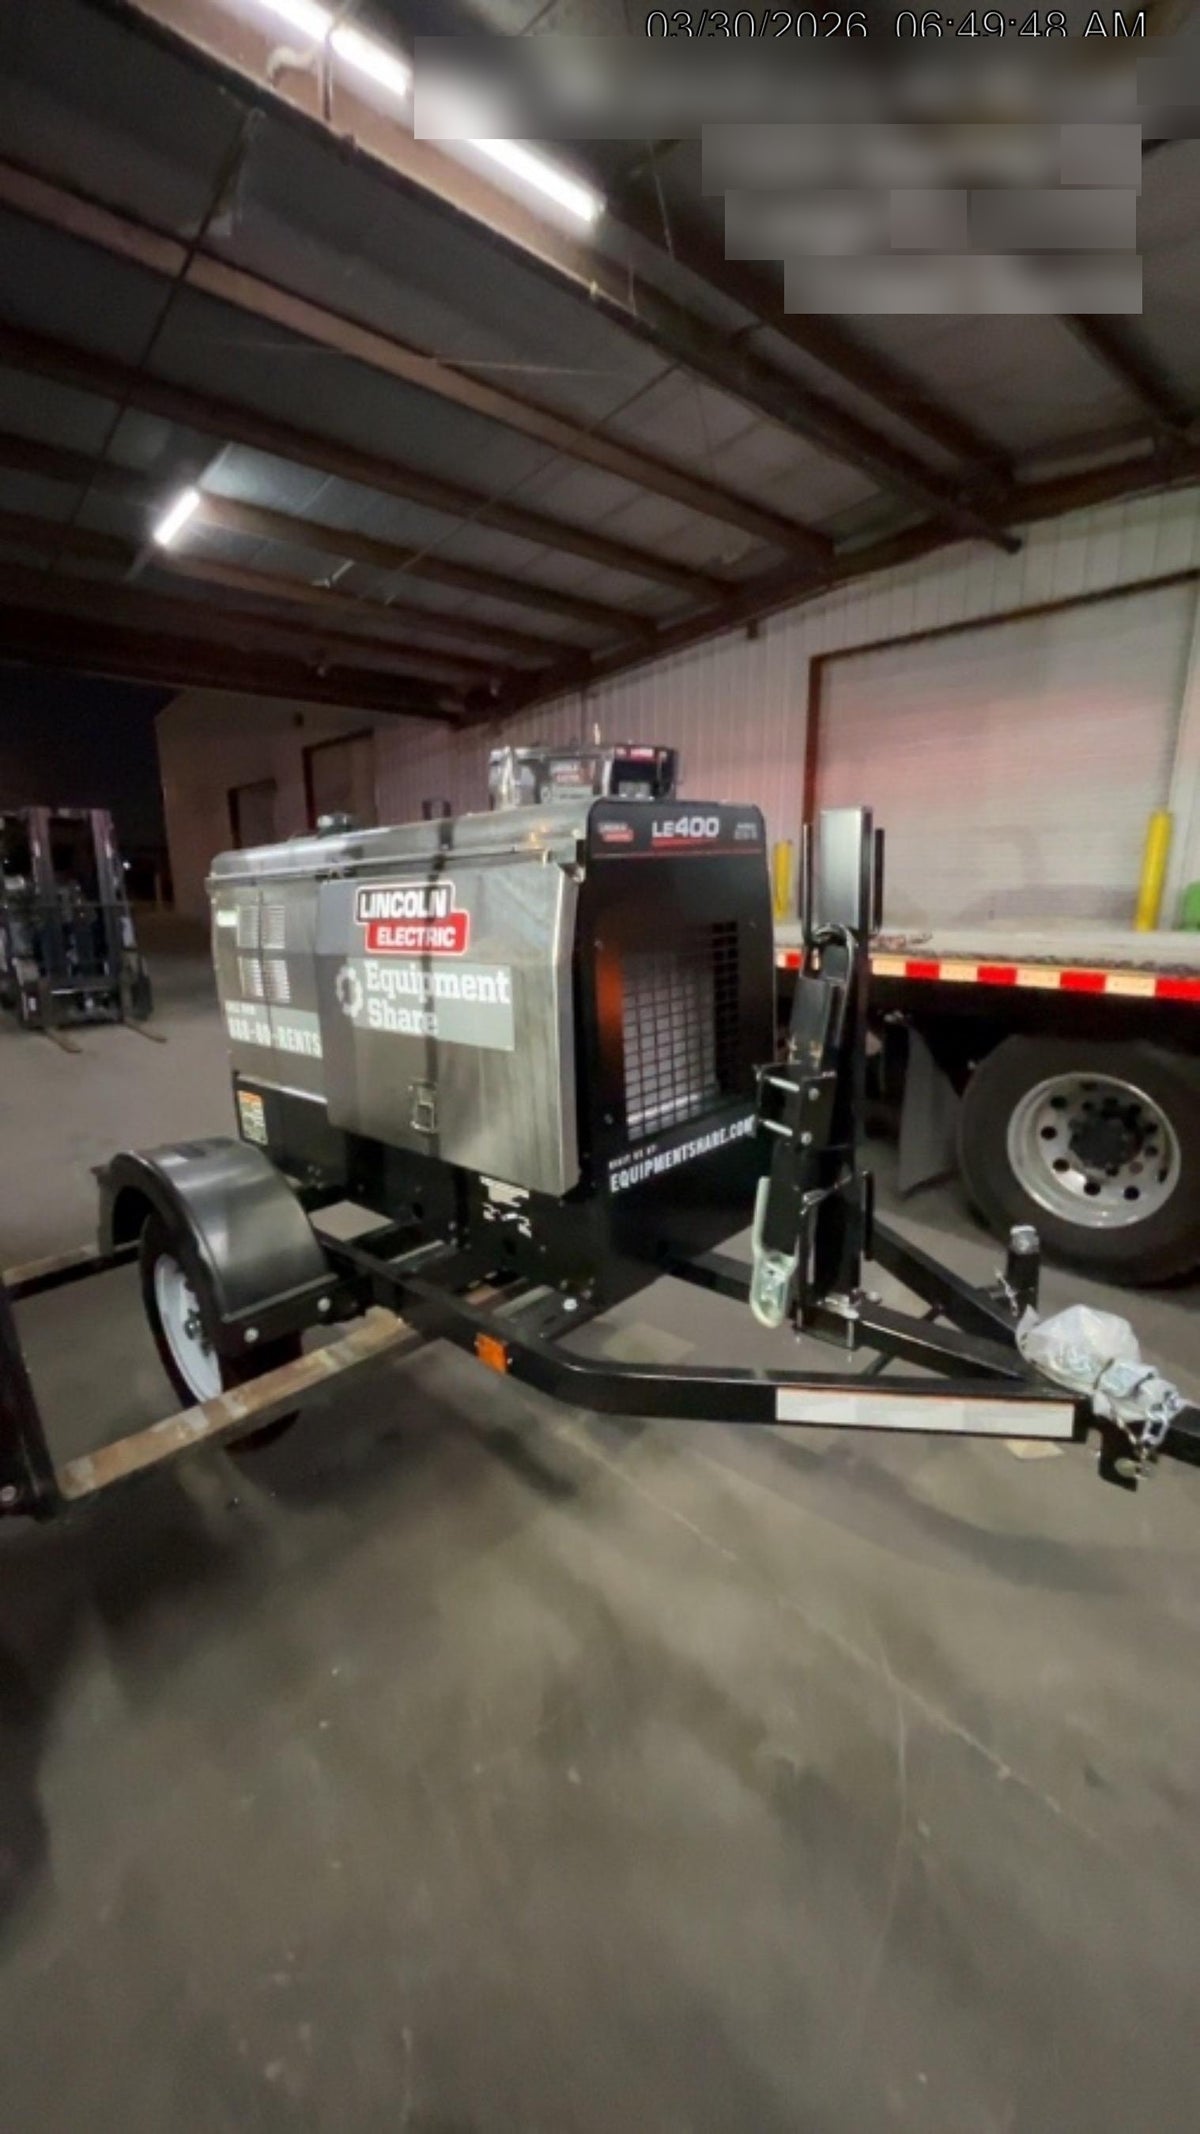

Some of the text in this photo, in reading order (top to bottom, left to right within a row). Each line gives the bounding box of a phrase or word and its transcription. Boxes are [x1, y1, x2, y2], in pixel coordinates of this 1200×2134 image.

[652, 816, 719, 838] LE400
[359, 888, 447, 918] LINCOLN
[377, 925, 457, 947] ELECTRIC
[363, 958, 511, 1004] Equipment
[366, 997, 439, 1036] Share
